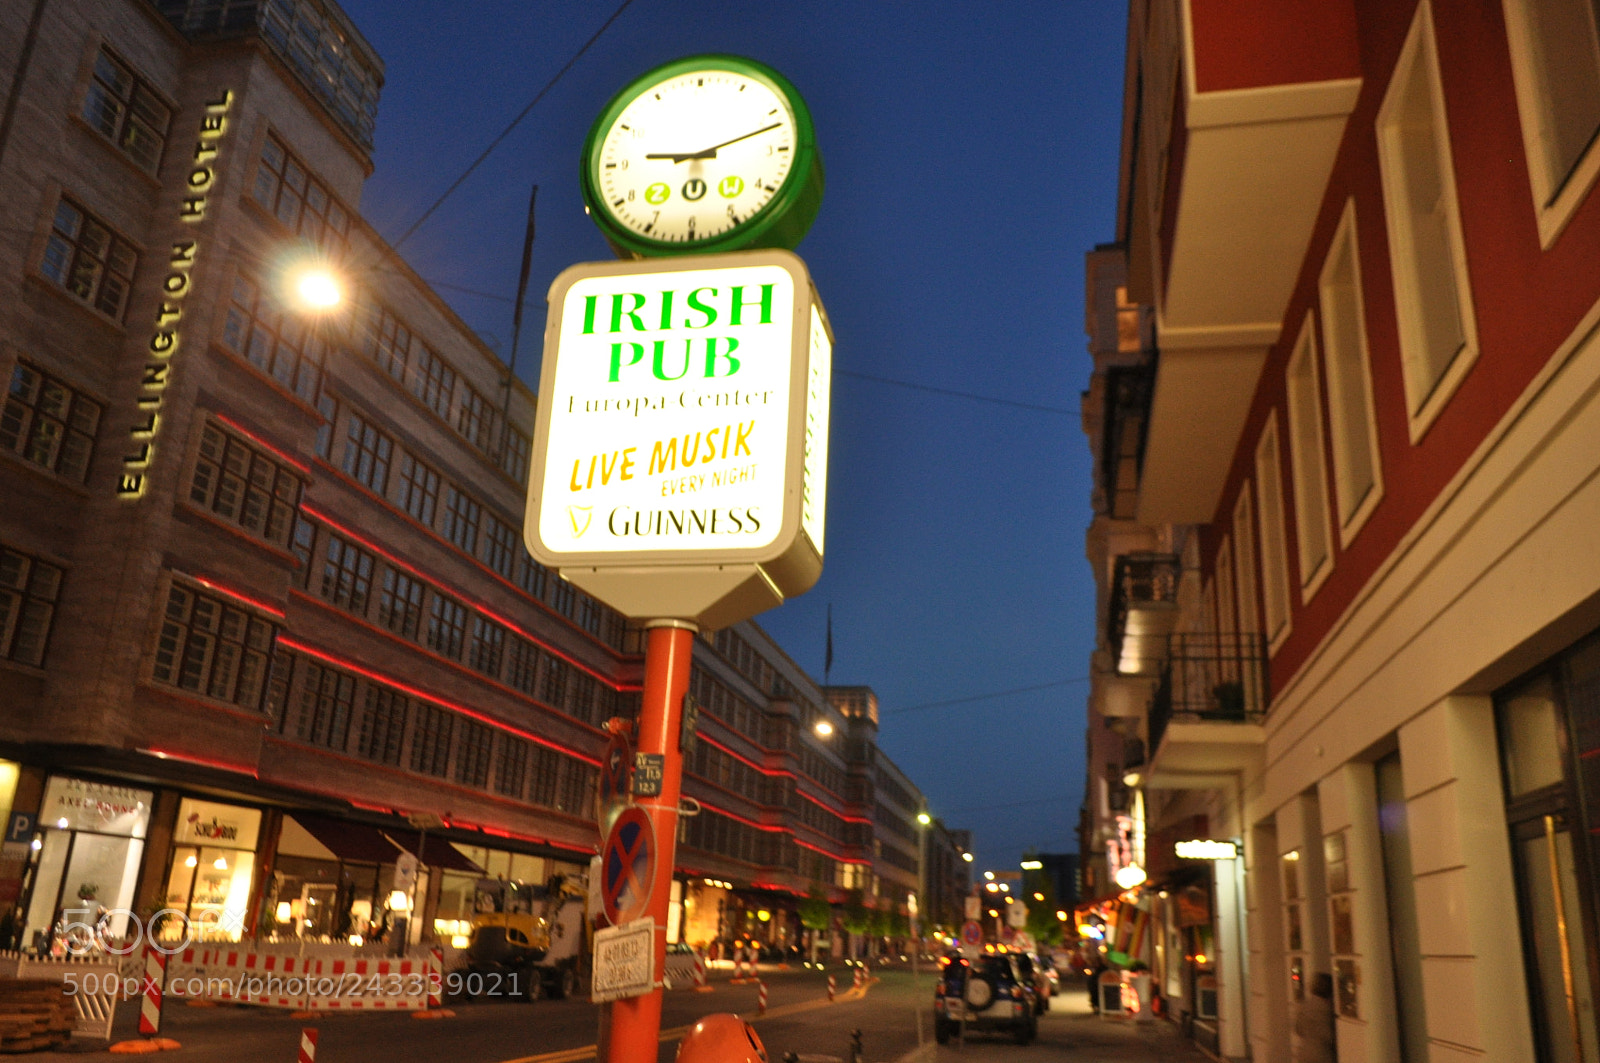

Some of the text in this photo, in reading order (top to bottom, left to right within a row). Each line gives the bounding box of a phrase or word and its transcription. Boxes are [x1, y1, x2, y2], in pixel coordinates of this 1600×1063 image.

[627, 189, 636, 202] 8
[754, 177, 763, 190] 4
[688, 216, 697, 229] 6
[117, 89, 234, 499] ELLINGTON HOTEL
[579, 283, 779, 335] IRISH
[607, 336, 741, 383] PUB
[569, 419, 755, 492] LIVE MUSIK
[661, 463, 759, 497] EVERY NIGHT
[607, 504, 761, 537] GUINNESS
[13, 815, 29, 839] P
